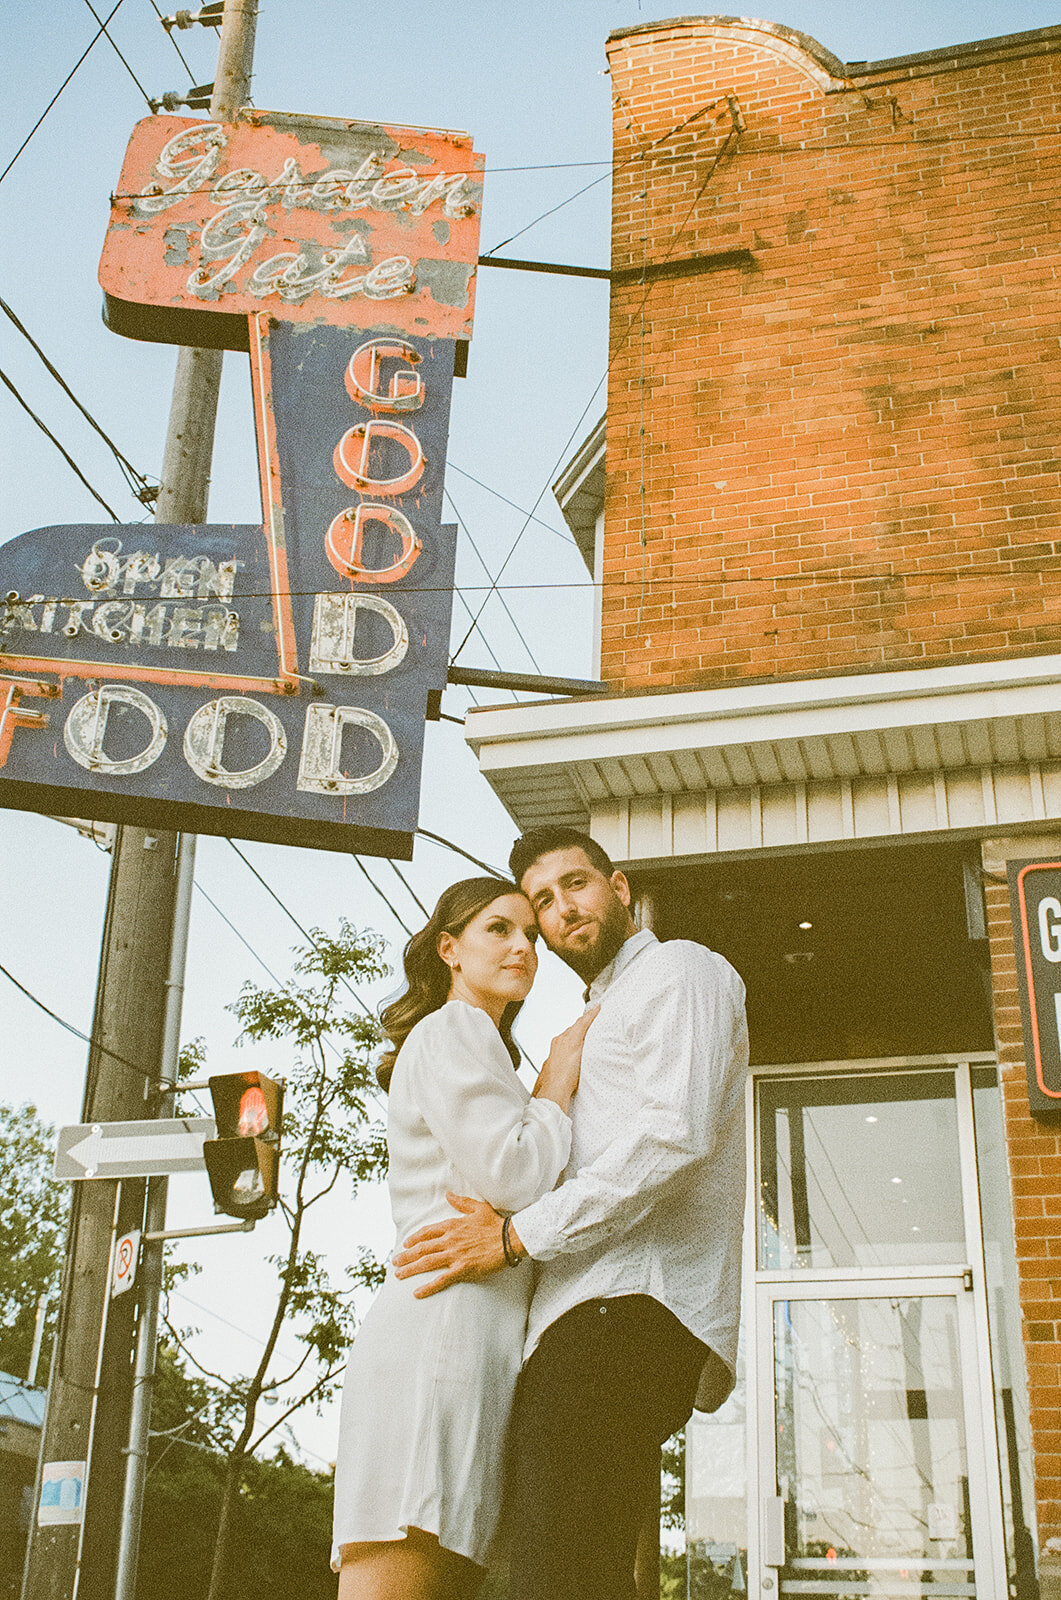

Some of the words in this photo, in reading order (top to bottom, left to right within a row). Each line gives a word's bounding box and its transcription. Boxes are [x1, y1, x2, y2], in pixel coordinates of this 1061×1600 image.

[134, 123, 476, 218] Garden
[187, 200, 414, 300] Gate
[309, 338, 426, 676] GOOD
